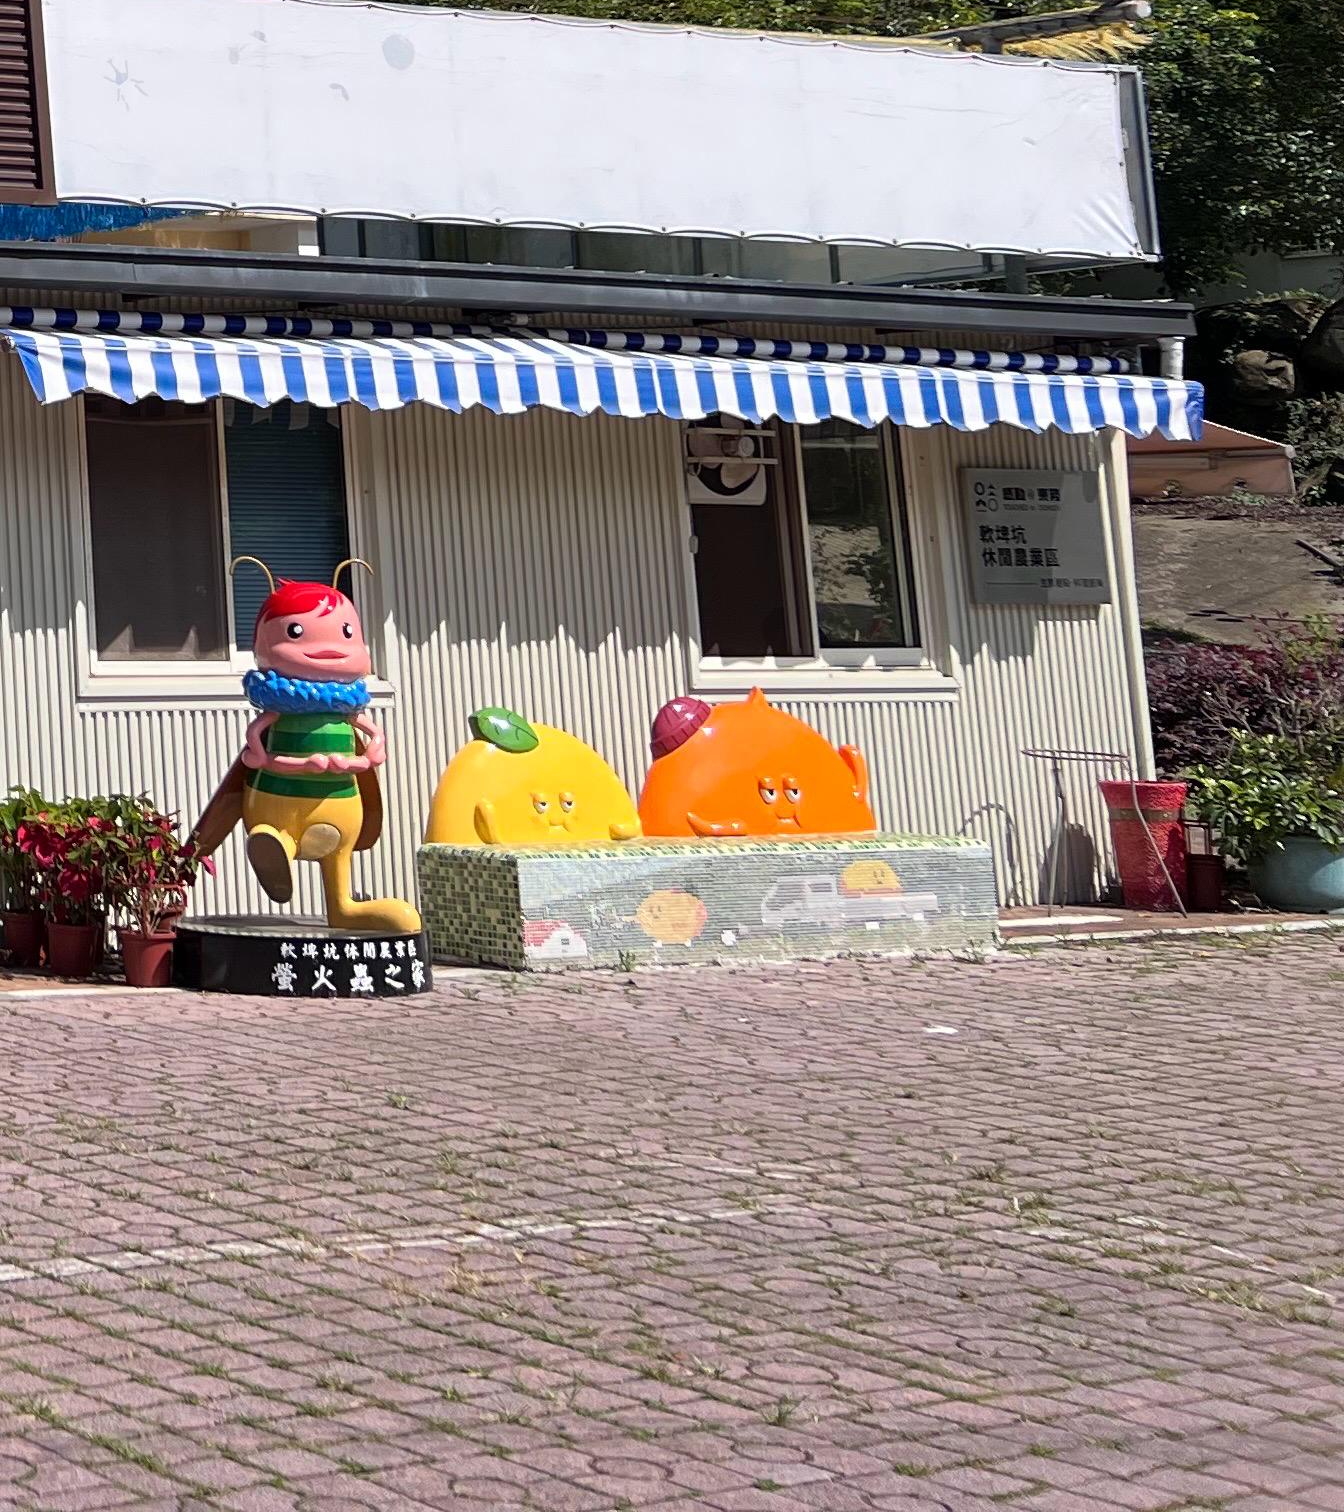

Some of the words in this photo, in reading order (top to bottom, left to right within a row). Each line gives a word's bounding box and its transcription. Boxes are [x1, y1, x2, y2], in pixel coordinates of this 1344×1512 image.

[271, 959, 425, 992] 螢火蟲之家
